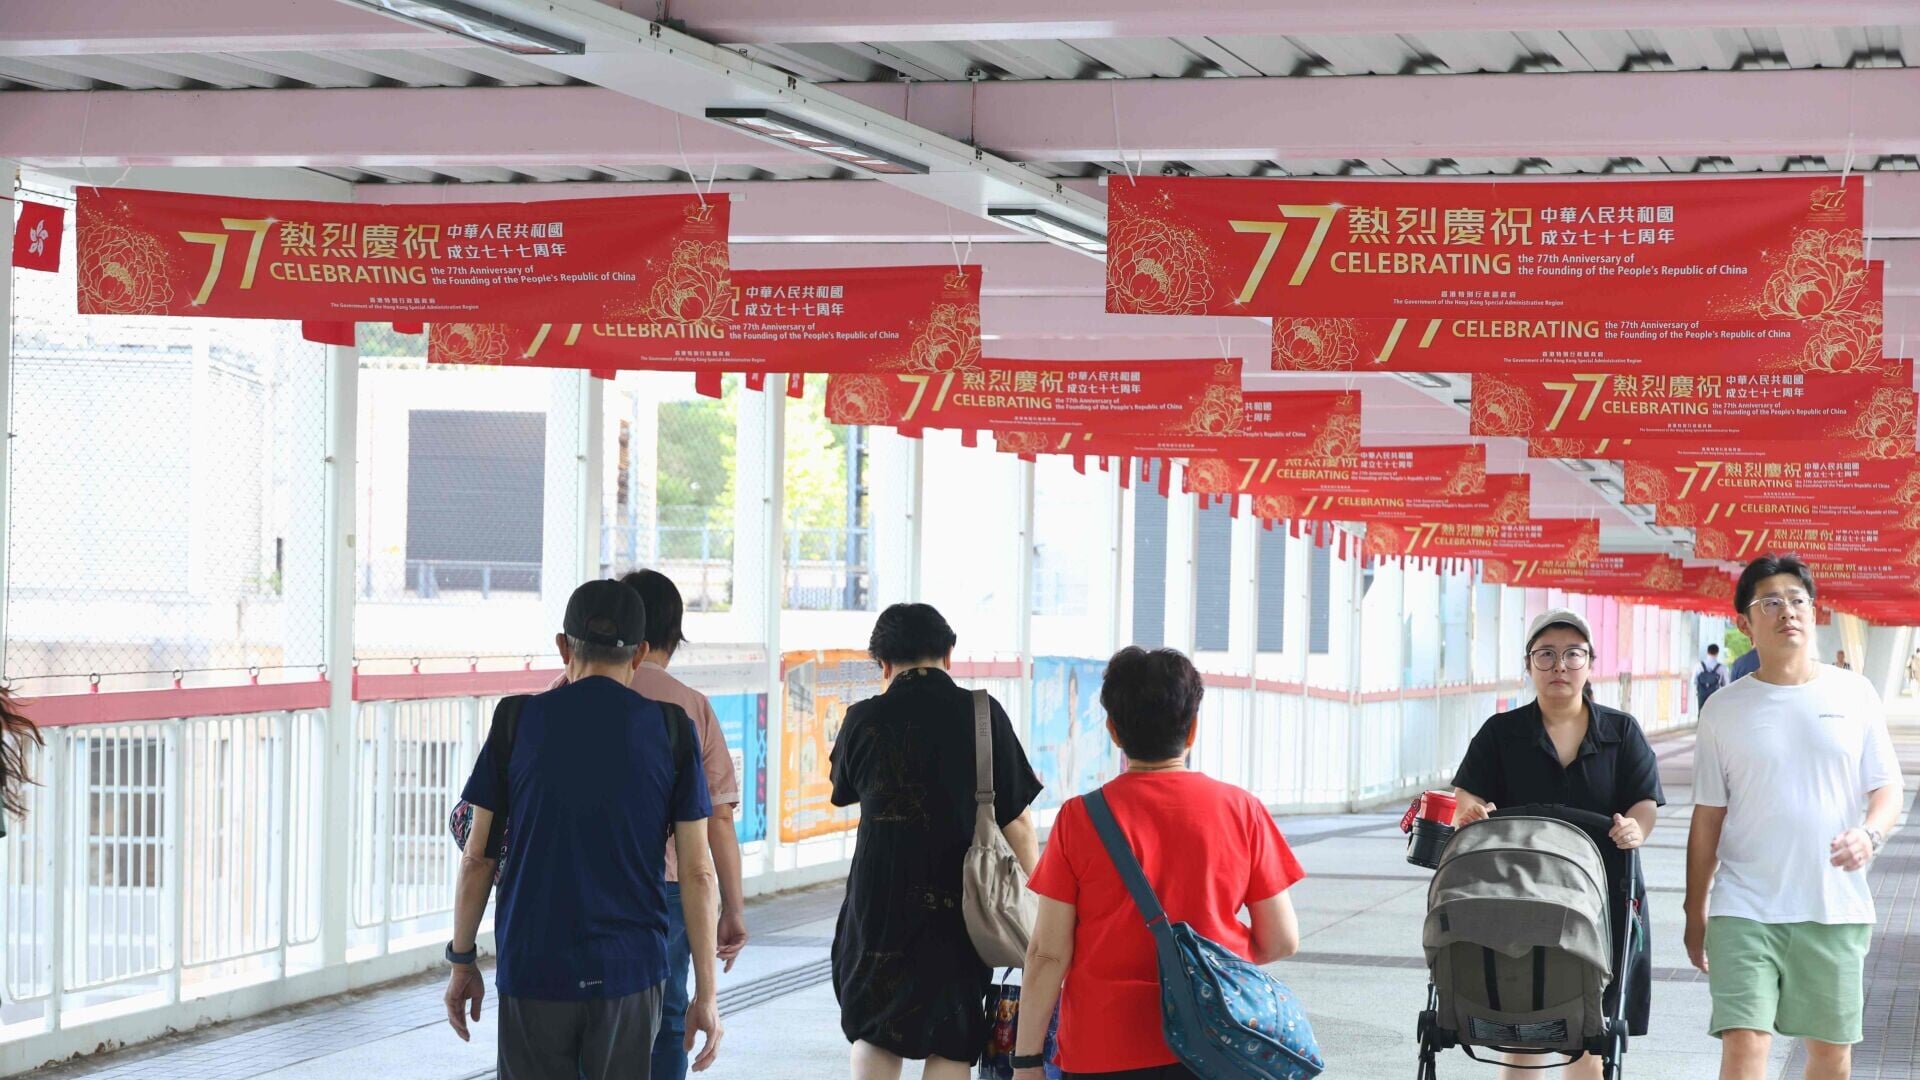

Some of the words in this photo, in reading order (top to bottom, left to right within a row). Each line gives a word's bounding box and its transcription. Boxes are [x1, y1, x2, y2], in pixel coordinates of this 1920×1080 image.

[1541, 206, 1674, 224] 中華人民共和國
[447, 222, 563, 239] 中華人民共和國
[1348, 206, 1533, 246] 熱烈慶祝
[280, 221, 442, 259] 熱烈慶祝
[1541, 229, 1675, 245] 成立七十七周年
[447, 243, 567, 260] 成立七十七周年
[1228, 204, 1338, 302] 77
[1518, 254, 1534, 263] the
[1538, 254, 1559, 263] 77th
[1562, 253, 1621, 265] Anniversary
[1624, 253, 1634, 263] of
[178, 218, 273, 304] 77
[1330, 251, 1512, 275] CELEBRATING
[270, 262, 427, 285] CELEBRATING
[431, 266, 445, 275] the
[447, 266, 467, 275] 77th
[470, 265, 522, 276] Anniversary
[525, 265, 534, 274] of
[1518, 265, 1534, 275] the
[1537, 265, 1583, 277] Founding
[1585, 265, 1596, 275] of
[1599, 265, 1615, 275] the
[1618, 265, 1658, 277] People's
[1661, 265, 1703, 277] Republic
[1706, 265, 1717, 275] of
[1720, 265, 1748, 275] China
[432, 276, 447, 285] the
[449, 275, 490, 287] Founding
[492, 275, 501, 284] of
[504, 275, 518, 284] the
[521, 274, 558, 285] People's
[560, 273, 598, 284] Republic
[601, 272, 610, 282] of
[612, 272, 636, 281] China
[746, 285, 844, 299] 中華人民共和國
[745, 303, 844, 317] 成立七十七周年
[592, 323, 725, 339] CELEBRATING
[761, 323, 805, 332] Anniversary
[1452, 320, 1599, 339] CELEBRATING
[1640, 321, 1688, 330] Anniversary
[743, 332, 778, 341] Founding
[803, 331, 834, 341] People's
[836, 331, 867, 341] Republic
[869, 331, 877, 339] of
[879, 331, 899, 339] China
[1605, 330, 1618, 338] the
[1620, 330, 1657, 340] Founding
[1660, 330, 1668, 338] of
[1670, 330, 1683, 338] the
[1686, 330, 1718, 340] People's
[1721, 330, 1755, 340] Republic
[962, 369, 1064, 393] 熱烈慶祝
[1613, 375, 1722, 399] 熱烈慶祝
[1726, 374, 1804, 385] 中華人民共和國
[1067, 384, 1141, 394] 成立七十七周年
[1726, 388, 1805, 398] 成立七十七周年
[952, 394, 1052, 409] CELEBRATING
[1542, 374, 1609, 431] 77
[1602, 401, 1709, 415] CELEBRATING
[1276, 469, 1349, 480] CELEBRATING
[1724, 462, 1802, 478] 熱烈慶祝
[1674, 461, 1722, 499] 77
[1717, 478, 1793, 488] CELEBRATING
[1338, 496, 1404, 507] CELEBRATING
[1740, 504, 1810, 514] CELEBRATING
[1404, 523, 1440, 553] 77
[1434, 537, 1491, 546] CELEBRATING
[1767, 541, 1826, 550] CELEBRATING
